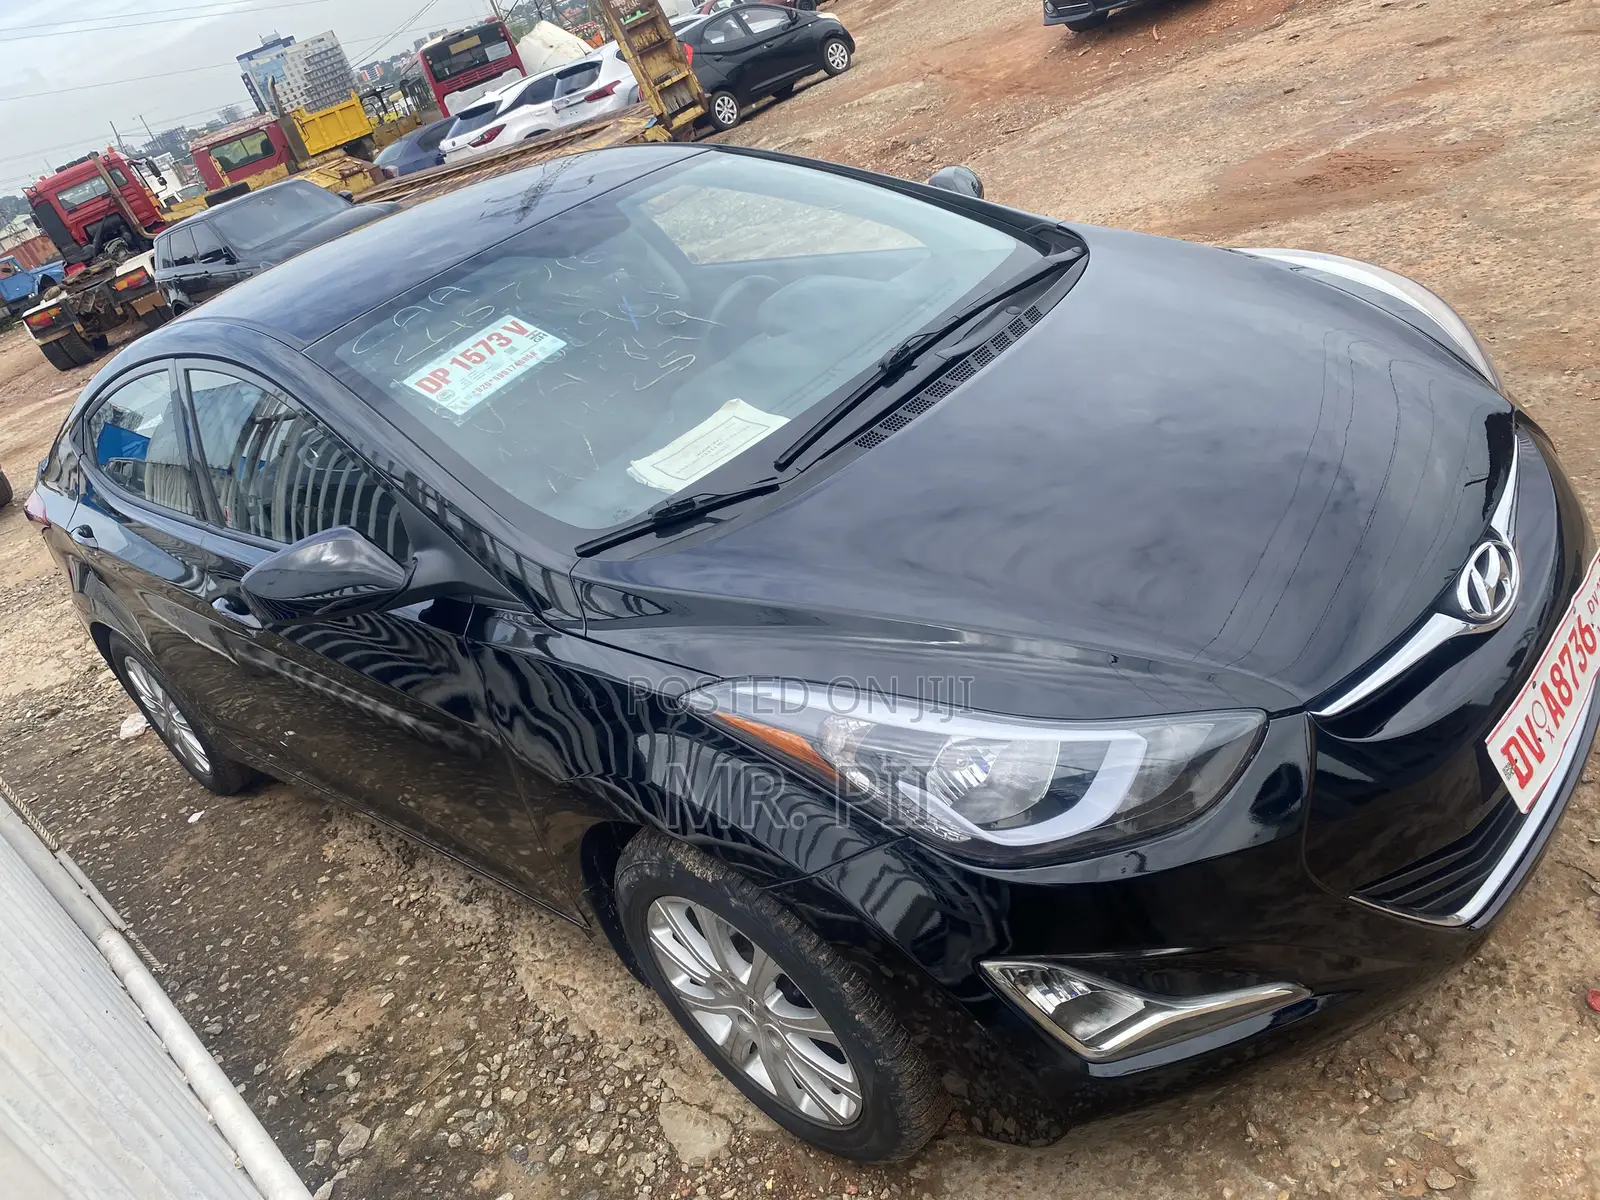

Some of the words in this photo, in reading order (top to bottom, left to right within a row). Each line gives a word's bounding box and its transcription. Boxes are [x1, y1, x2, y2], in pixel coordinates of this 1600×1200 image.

[415, 367, 452, 395] DP
[449, 332, 513, 371] 1573
[502, 320, 529, 337] V
[1500, 714, 1546, 790] DV
[1540, 614, 1598, 730] A8736
